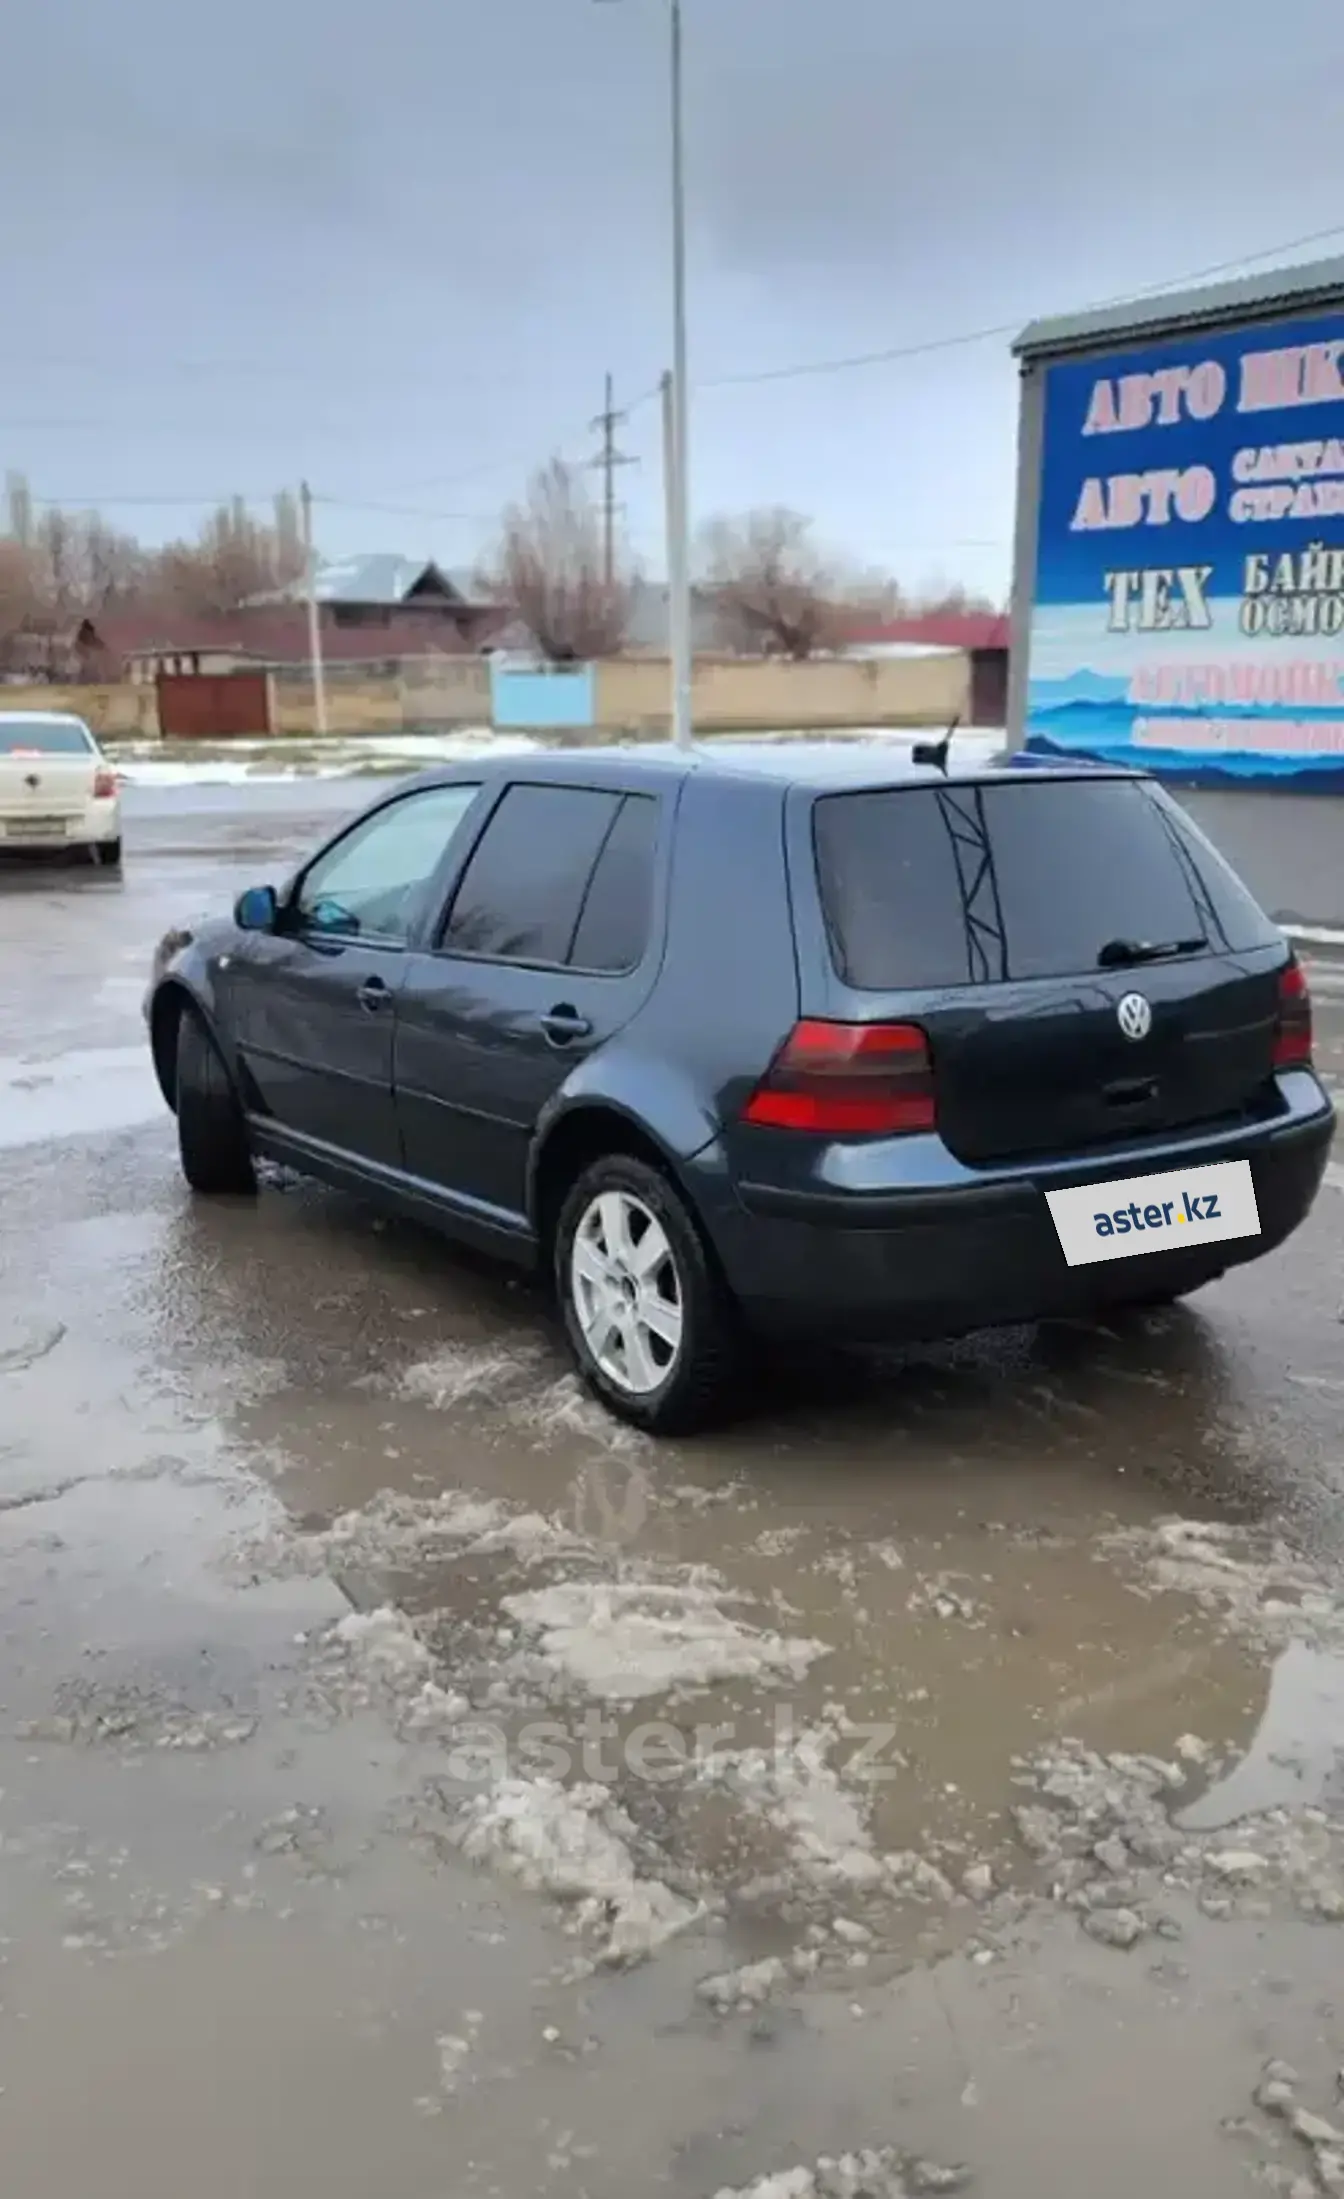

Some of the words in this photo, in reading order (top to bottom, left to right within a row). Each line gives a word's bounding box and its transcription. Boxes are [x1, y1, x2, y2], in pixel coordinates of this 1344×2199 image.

[1081, 361, 1226, 436] АВТО
[1070, 466, 1216, 532] АВТО
[1104, 566, 1213, 632] ТЕХ
